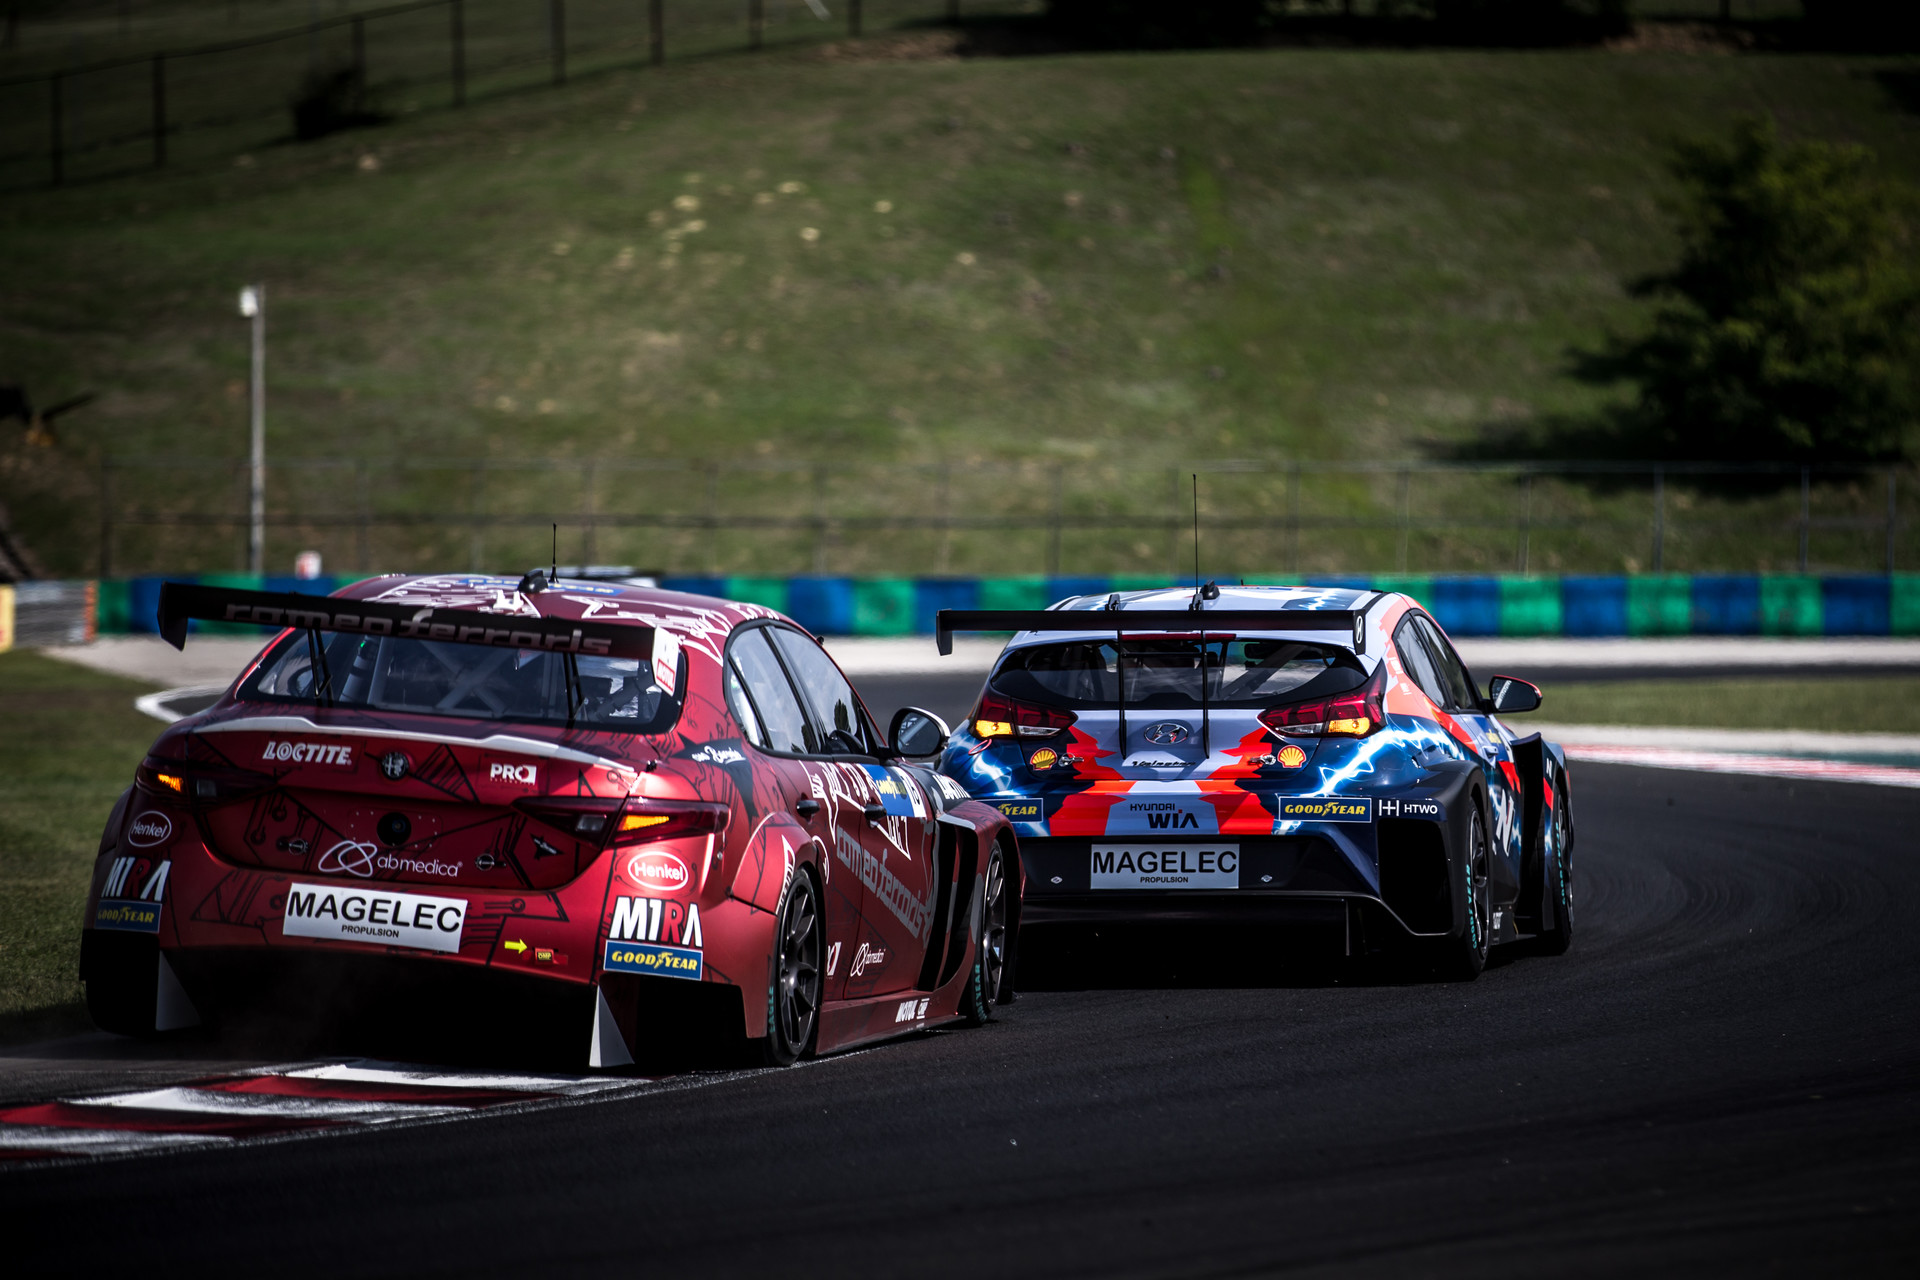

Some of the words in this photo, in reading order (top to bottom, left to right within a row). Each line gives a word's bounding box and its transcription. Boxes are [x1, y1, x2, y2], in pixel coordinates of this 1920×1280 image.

[262, 740, 352, 766] LOCTITE
[1130, 803, 1176, 811] HYUNDAI
[1285, 802, 1366, 817] GOODYEAR
[1404, 804, 1438, 815] HTWO
[130, 820, 168, 838] Henkel
[634, 862, 684, 882] Henkel
[1092, 851, 1238, 875] MAGELEC
[1139, 876, 1189, 884] PROPULSION
[287, 891, 462, 933] MAGELEC
[341, 924, 400, 938] PROPULSION
[611, 950, 698, 971] GOODYEAR
